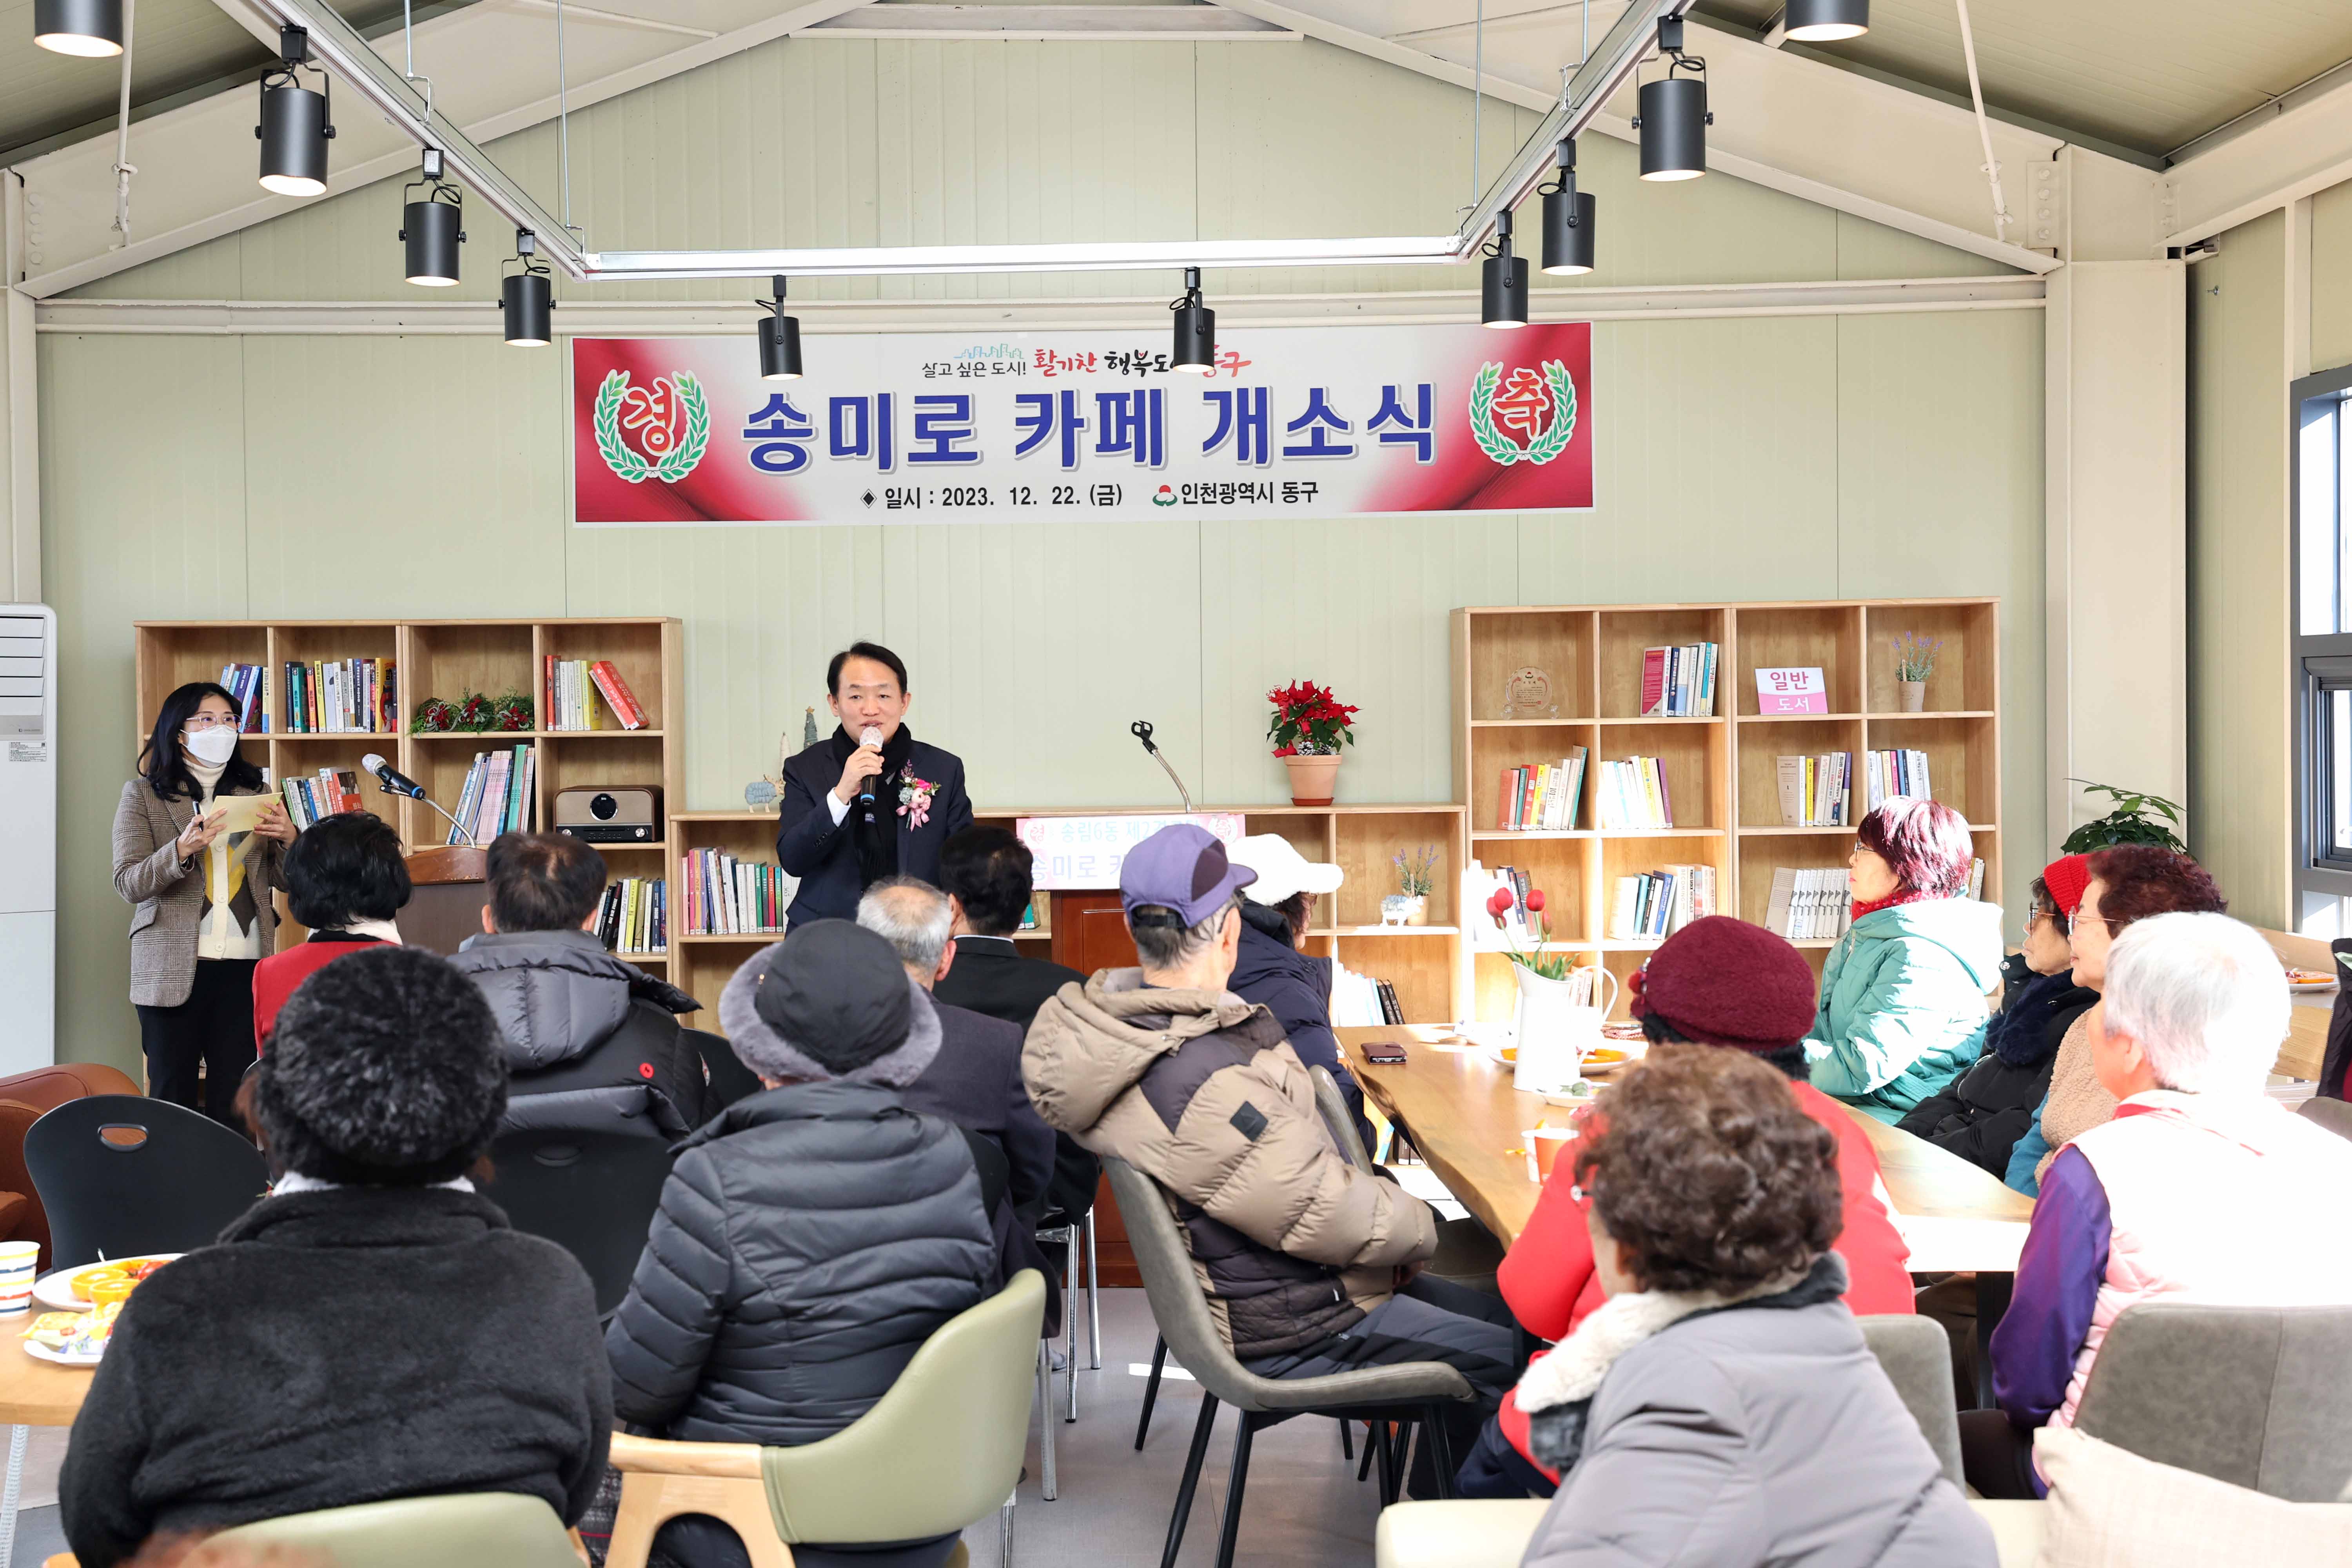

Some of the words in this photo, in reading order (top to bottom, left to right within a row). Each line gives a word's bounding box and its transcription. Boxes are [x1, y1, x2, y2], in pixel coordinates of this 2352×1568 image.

[922, 363, 953, 378] 살고
[956, 361, 987, 377] 싶은
[991, 361, 1027, 376] 도시!
[1034, 348, 1097, 377] 활기찬
[1103, 349, 1174, 378] 행복도
[626, 379, 673, 454] 경
[1494, 370, 1547, 438] 축
[743, 392, 979, 473] 송미로
[1014, 388, 1163, 468] 카페
[1202, 383, 1432, 466] 개소식
[885, 487, 920, 509] 일시
[942, 487, 994, 506] 2023.
[1009, 486, 1037, 505] 12.
[1052, 486, 1080, 505] 22.
[1089, 483, 1122, 506] (금)
[1181, 481, 1274, 505] 인천광역시
[1281, 481, 1319, 504] 동구
[1770, 671, 1809, 690] 일반
[1777, 697, 1810, 712] 도서
[1061, 821, 1118, 843] 송림6동
[1032, 855, 1098, 882] 송미로
